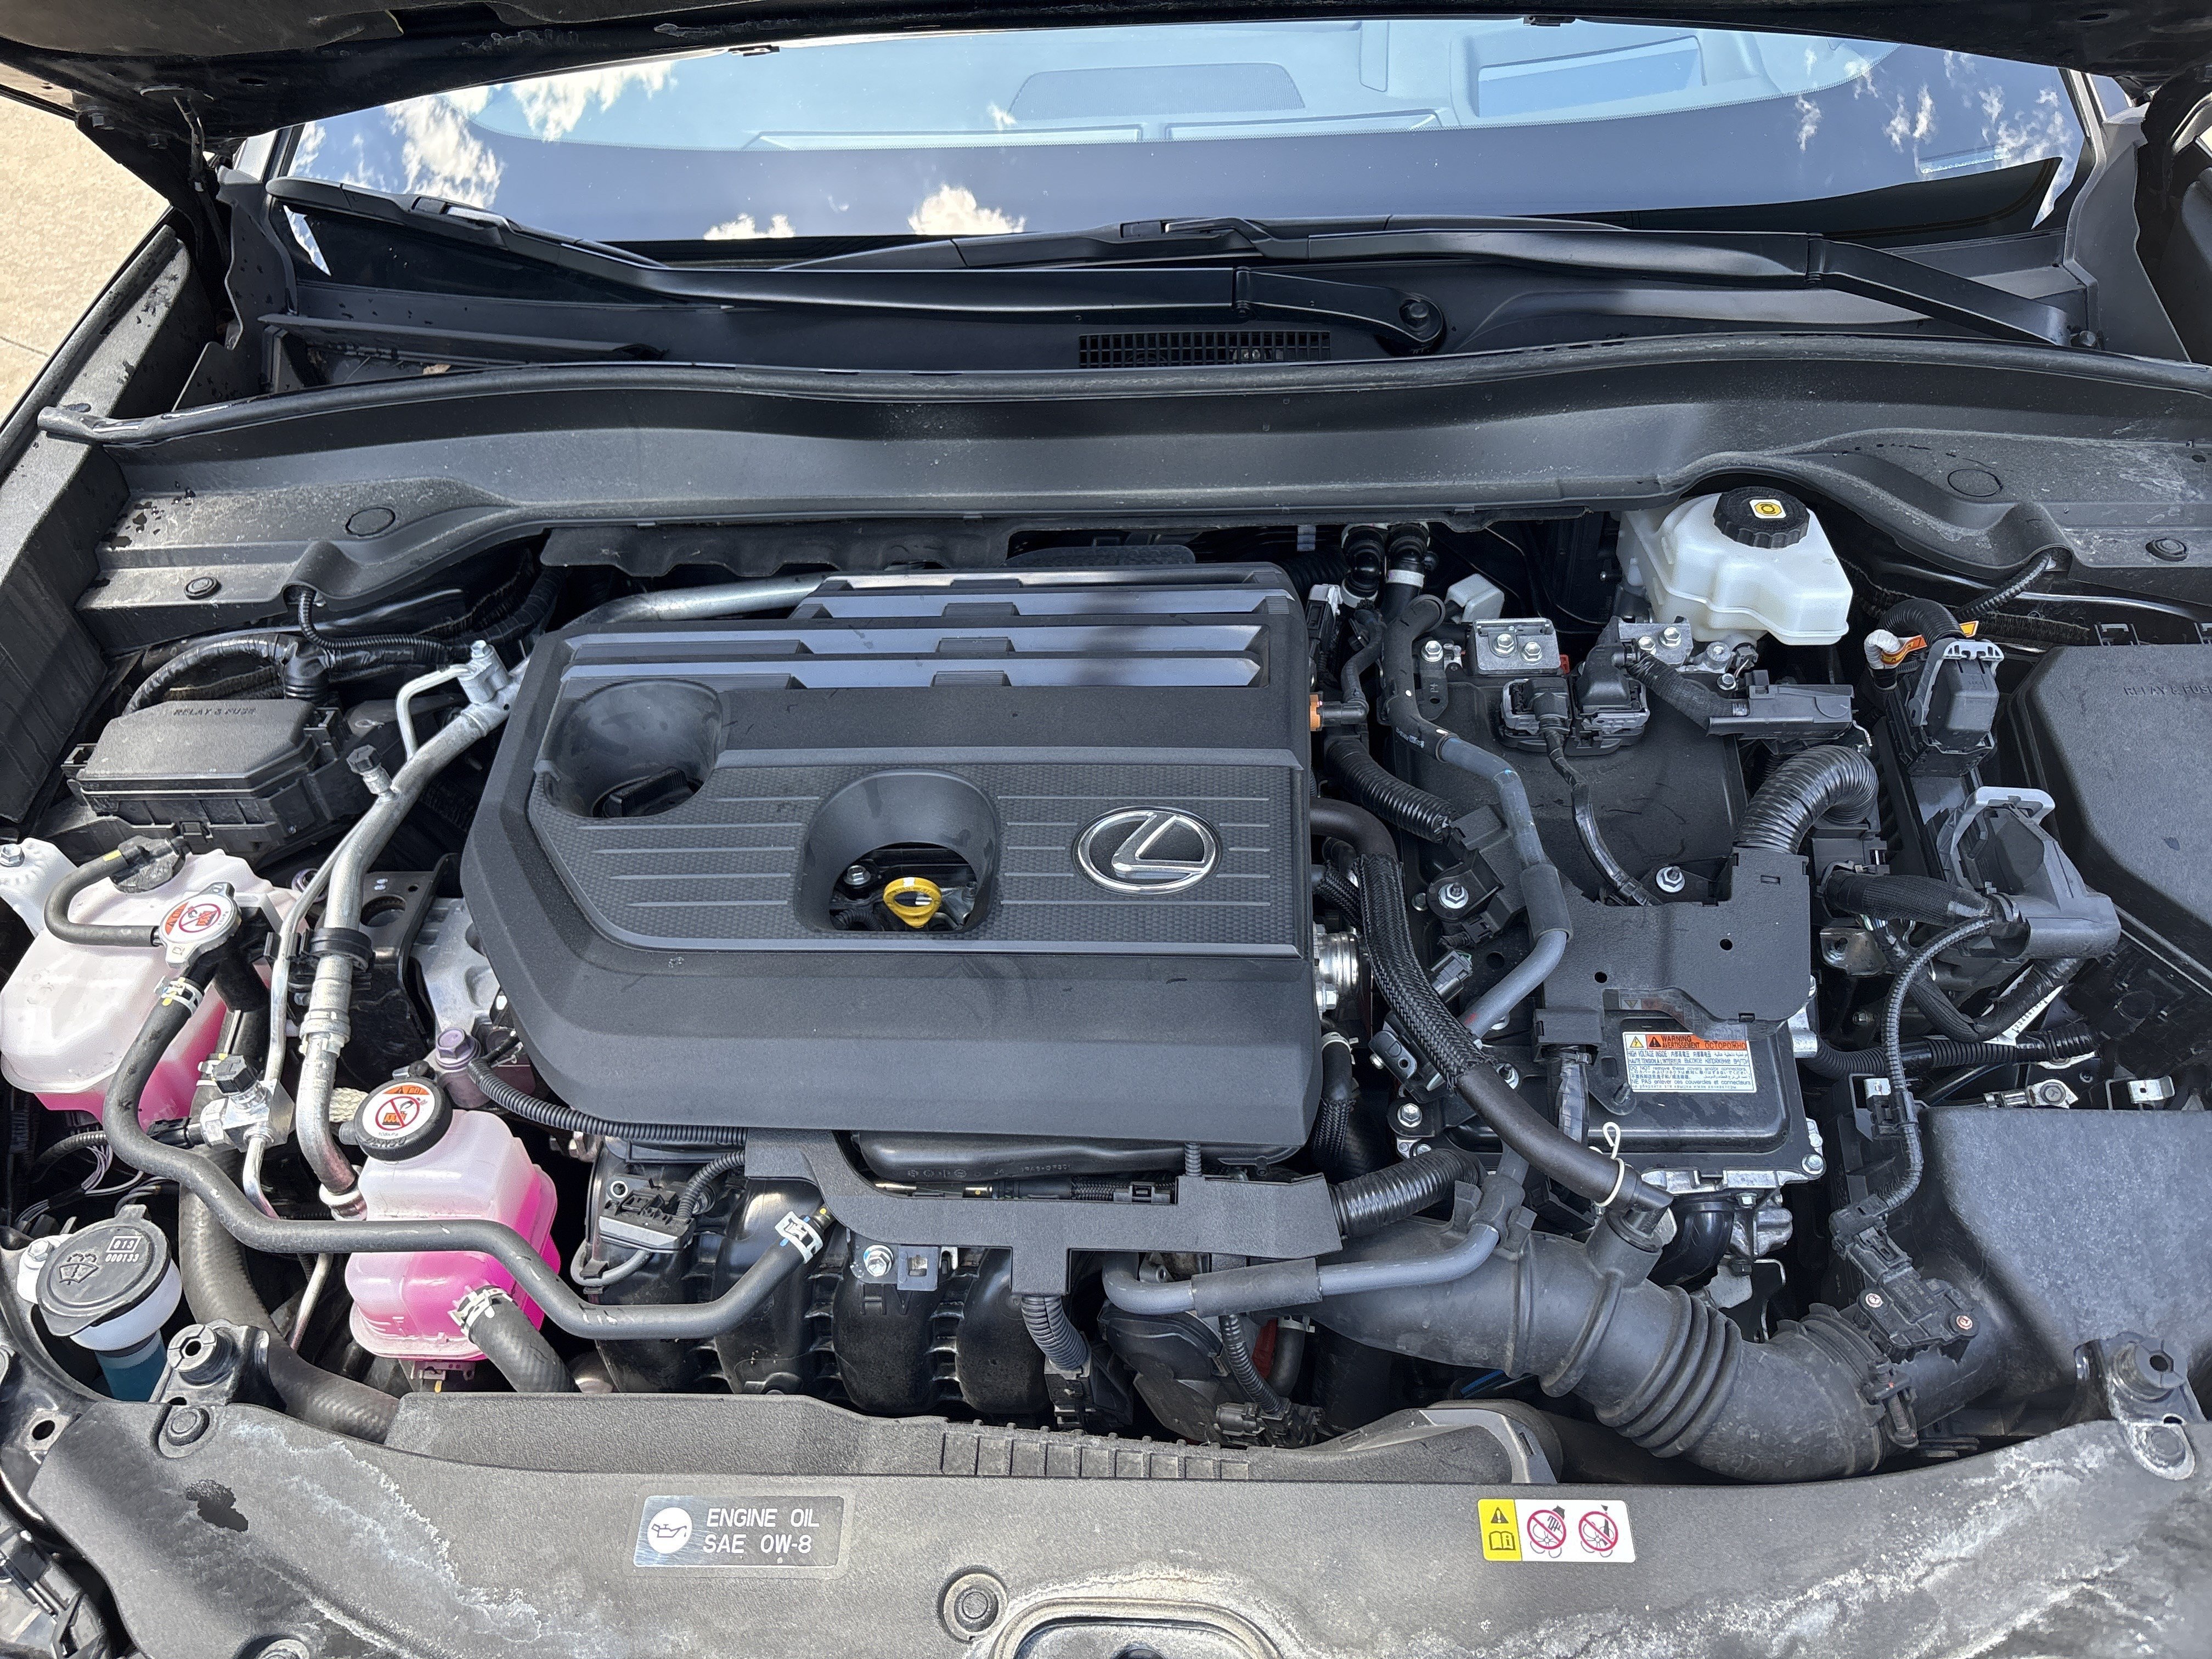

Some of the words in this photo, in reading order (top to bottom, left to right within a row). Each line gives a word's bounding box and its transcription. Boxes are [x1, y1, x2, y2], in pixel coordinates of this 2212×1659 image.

[706, 1508, 778, 1527] ENGINE
[790, 1509, 820, 1527] OIL
[703, 1534, 747, 1554] SAE
